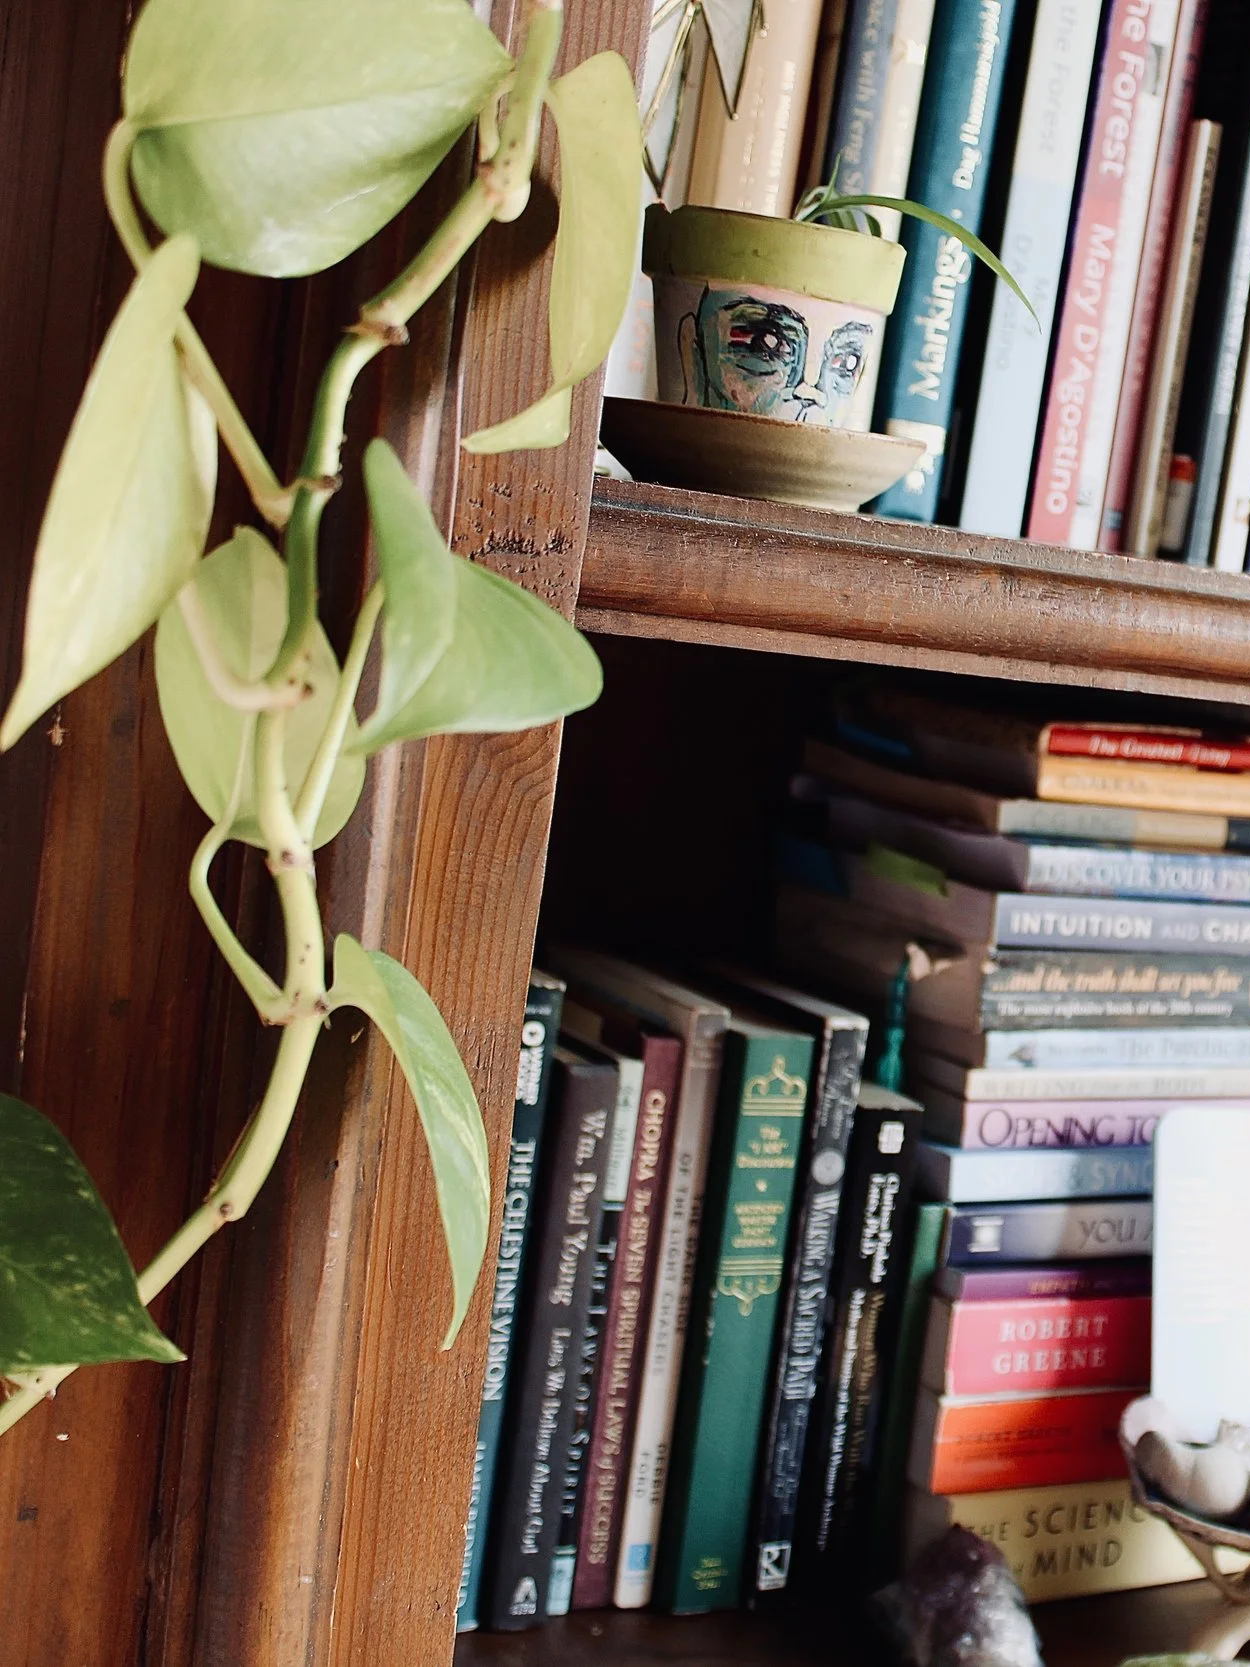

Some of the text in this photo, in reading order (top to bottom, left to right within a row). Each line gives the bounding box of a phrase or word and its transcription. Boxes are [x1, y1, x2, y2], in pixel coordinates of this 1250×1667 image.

[1099, 50, 1145, 178] Forest
[1074, 223, 1116, 316] Mary
[908, 234, 972, 401] Markings
[1044, 323, 1098, 515] D'Agostino
[1043, 861, 1152, 886] DISCOVER
[1156, 866, 1215, 891] YOUR
[1010, 911, 1153, 940] INTUITION
[1160, 922, 1201, 942] AND
[636, 1088, 667, 1183] CHOPRA
[978, 1108, 1115, 1147] OPENING
[566, 1171, 598, 1226] Paul
[801, 1190, 840, 1267] WALKING
[1076, 1216, 1136, 1250] YOU
[482, 1137, 538, 1401] THE CELESTINE VISION
[549, 1227, 589, 1307] Young
[623, 1213, 650, 1284] SEVEN
[651, 1152, 692, 1377] OF THE LIGHT CHASERS
[608, 1284, 642, 1396] SPIRITUAL
[790, 1283, 828, 1354] SACRED
[998, 1316, 1109, 1343] ROBERT
[782, 1356, 818, 1400] PATH
[992, 1348, 1107, 1375] GREENE
[602, 1396, 627, 1457] LAWS
[587, 1467, 618, 1566] SUCCESS
[1023, 1499, 1146, 1538] SCIENC
[1031, 1540, 1123, 1578] MIND
